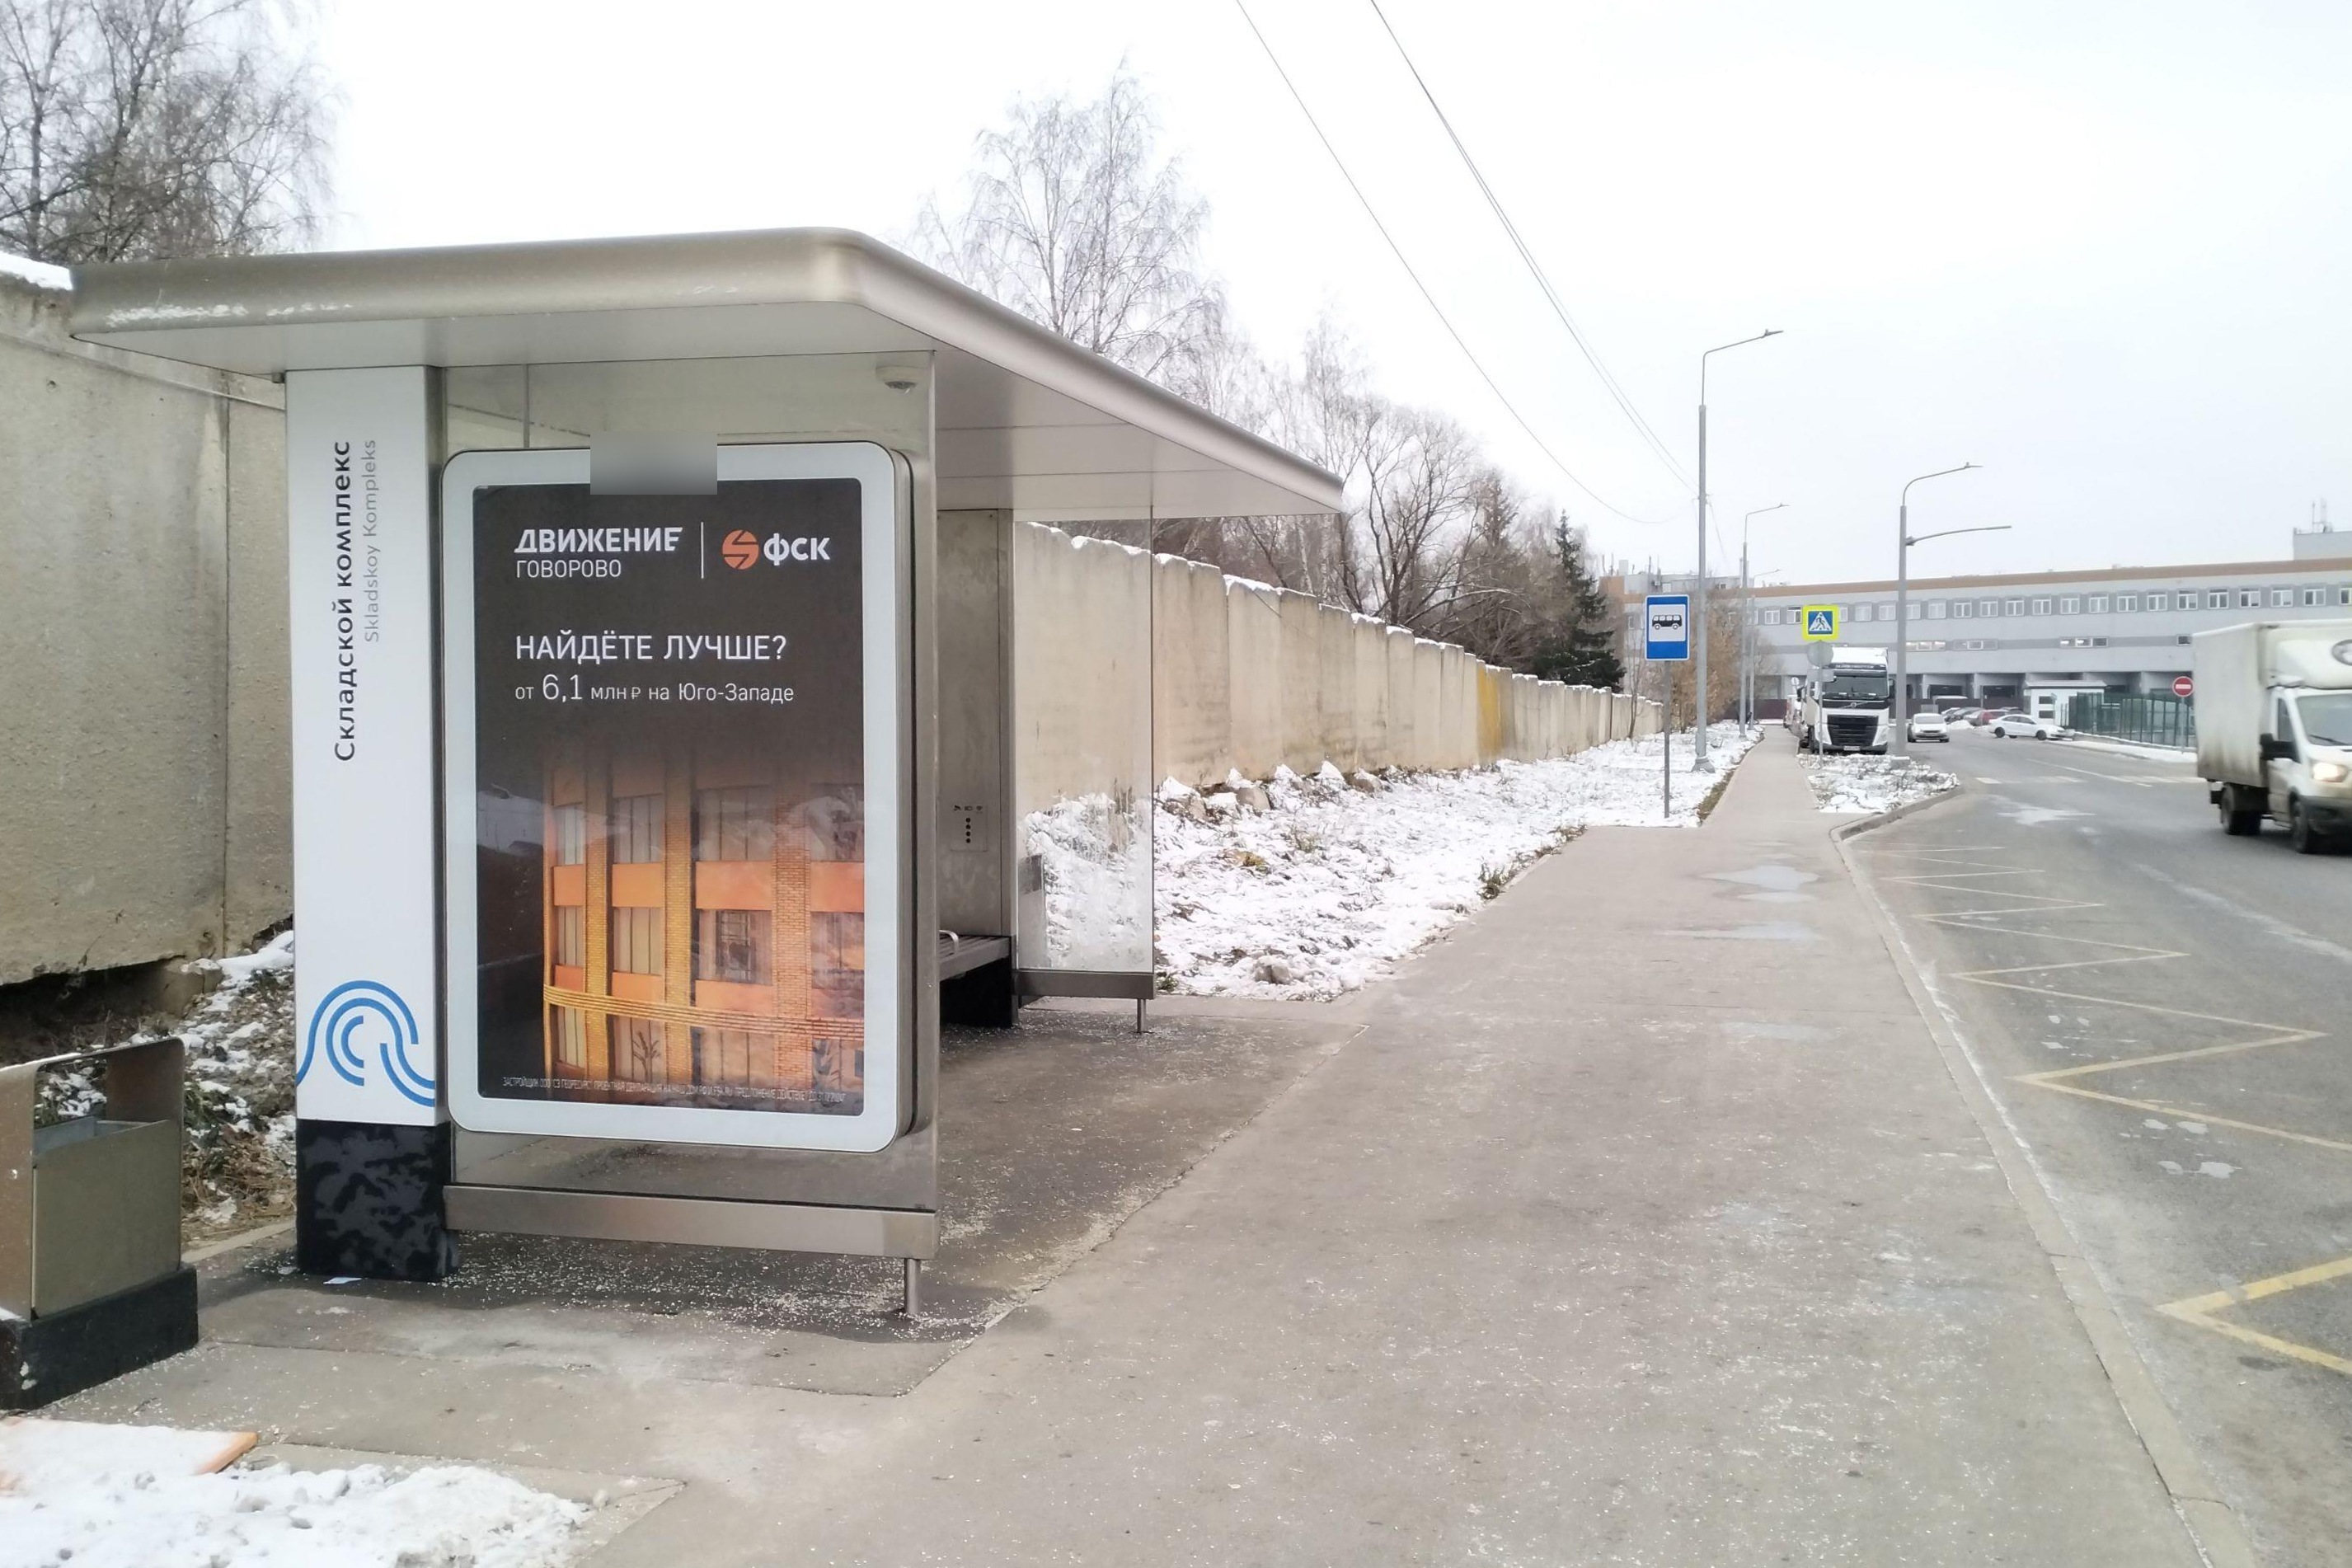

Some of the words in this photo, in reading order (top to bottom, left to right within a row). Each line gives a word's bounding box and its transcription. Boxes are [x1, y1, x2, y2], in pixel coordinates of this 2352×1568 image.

[359, 439, 380, 537] Kompleks
[334, 441, 352, 587] комплекс
[514, 527, 683, 553] ДВИЖЕНИЕ
[763, 533, 831, 566] ФСК
[516, 559, 622, 578] ГОВОРОВО
[363, 544, 381, 643] Skladskoy
[516, 629, 653, 665] НАЙДЁТЕ
[663, 635, 787, 660] ЛУЧШЕ?
[331, 599, 358, 761] Складской
[515, 686, 534, 700] от
[542, 674, 583, 703] 6,1
[648, 687, 669, 701] на
[678, 683, 794, 705] Юго-Западе
